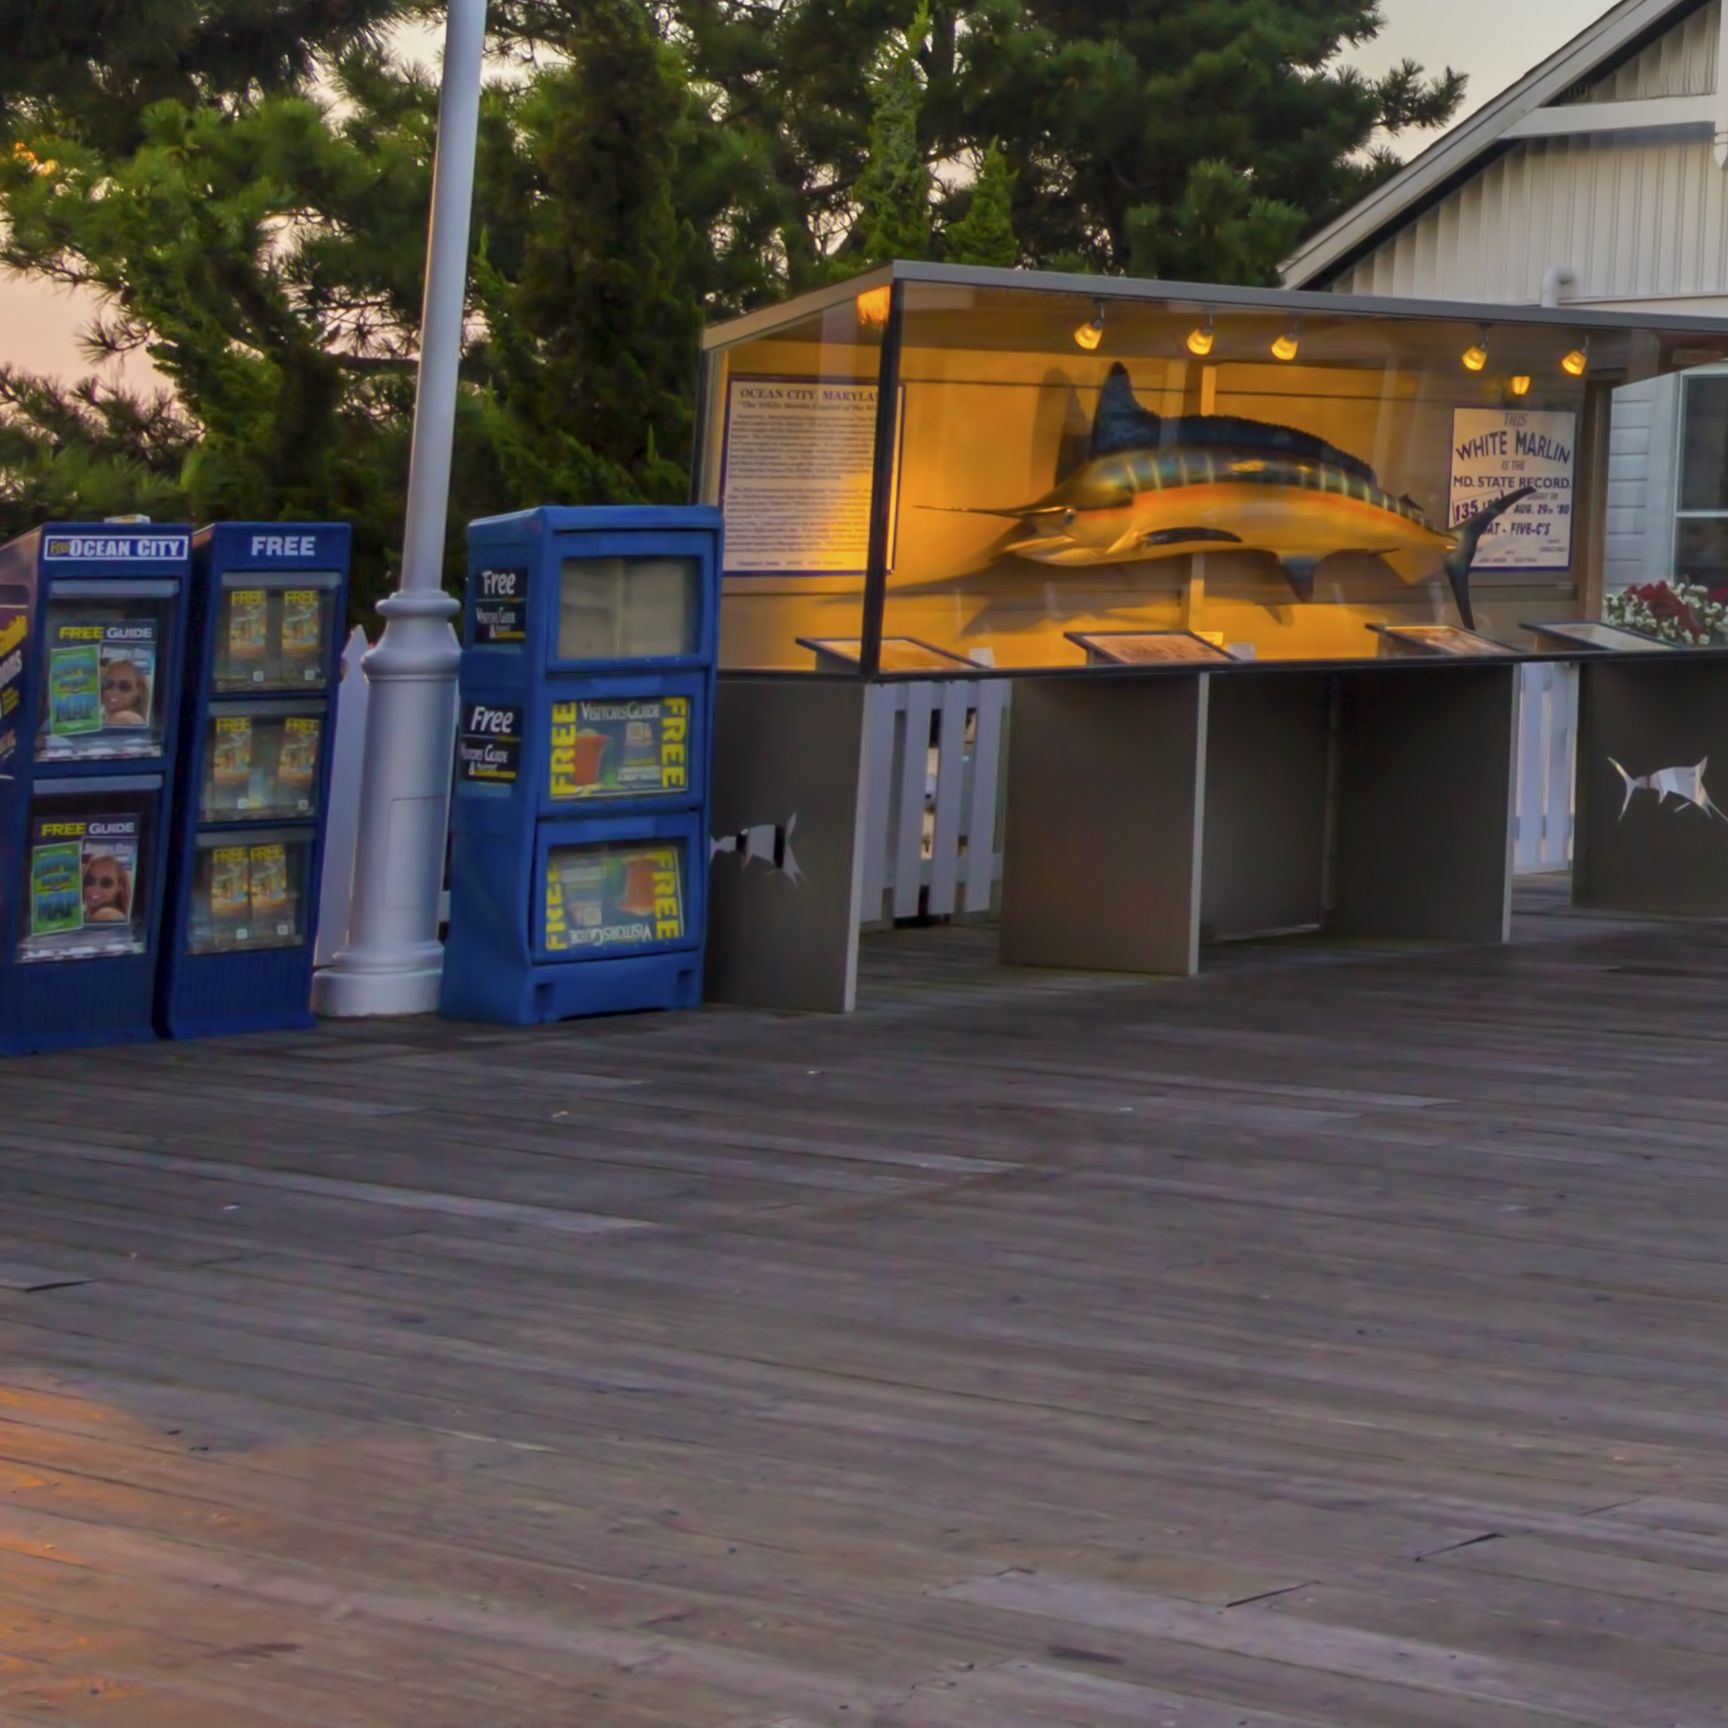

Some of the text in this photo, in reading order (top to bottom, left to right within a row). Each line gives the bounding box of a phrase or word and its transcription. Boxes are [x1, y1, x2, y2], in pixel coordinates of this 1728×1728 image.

[822, 390, 879, 402] MARYLA
[1504, 412, 1528, 427] THIS
[1455, 429, 1572, 465] WHITE MARLIN
[1501, 460, 1525, 471] IS THE
[1453, 476, 1475, 488] MD.
[1478, 476, 1515, 488] STATE
[1455, 500, 1478, 521] 135
[1513, 505, 1534, 515] AUG.
[69, 539, 130, 557] OCEAN
[137, 539, 181, 557] CITY
[251, 536, 316, 556] FREE
[481, 570, 516, 595] Free
[59, 626, 152, 639] FREE GUIDE
[470, 705, 514, 734] Free
[550, 701, 577, 797] FREE
[662, 697, 688, 790] FREE
[41, 822, 135, 837] FREE GUIDE
[647, 850, 679, 940] FREE
